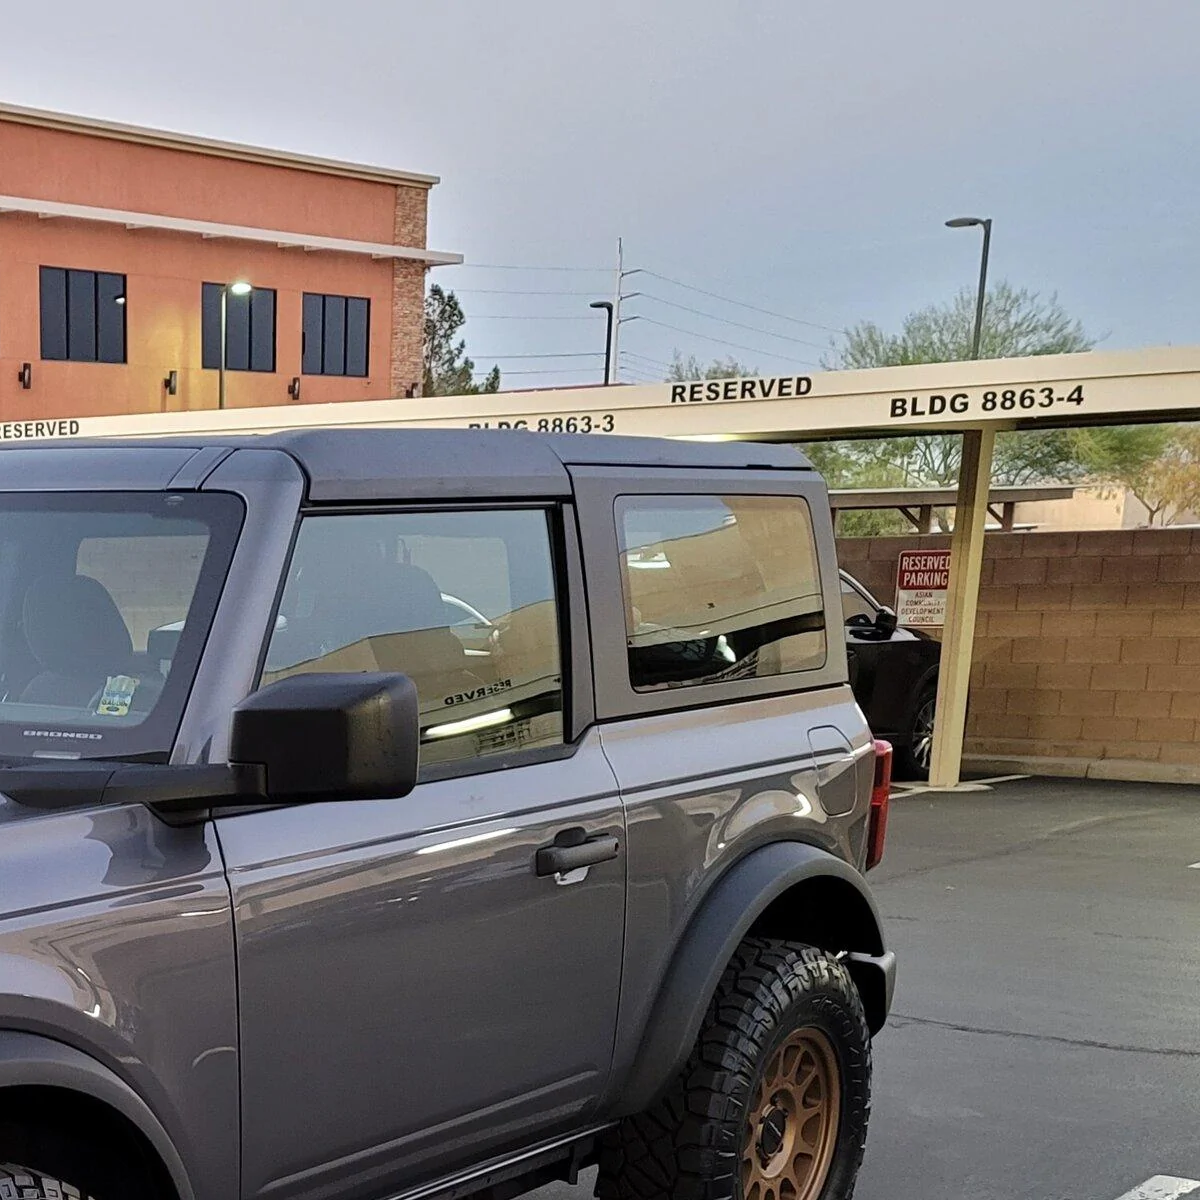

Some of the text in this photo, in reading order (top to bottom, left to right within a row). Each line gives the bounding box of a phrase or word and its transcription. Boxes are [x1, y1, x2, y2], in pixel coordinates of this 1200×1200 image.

[671, 376, 813, 403] RESERVED
[890, 385, 1084, 418] BLDG 8863-4
[537, 414, 615, 434] 8863-3
[902, 555, 951, 571] RESERVED
[903, 572, 948, 586] PARKING
